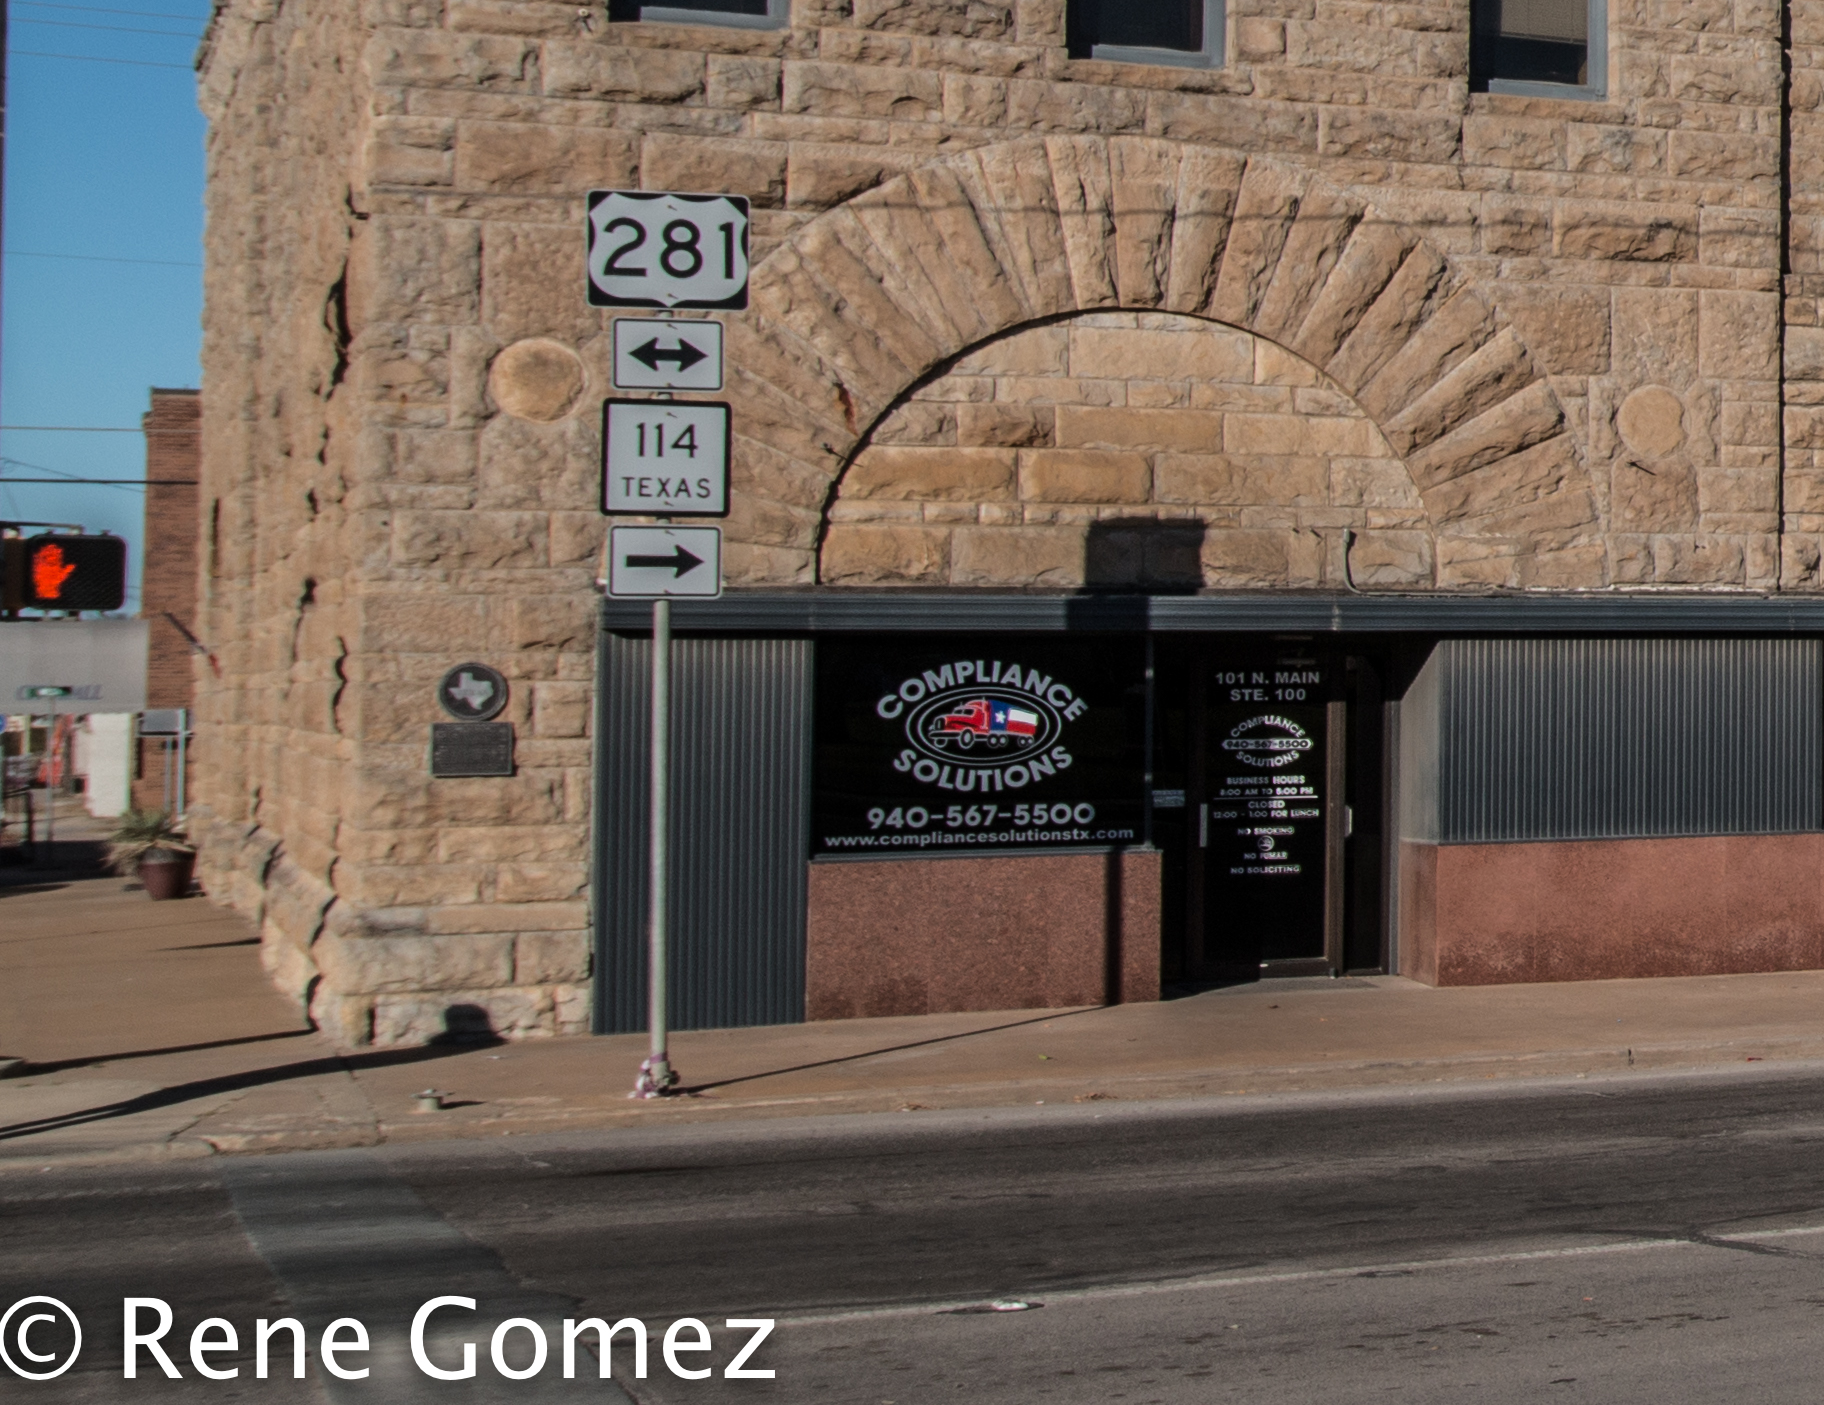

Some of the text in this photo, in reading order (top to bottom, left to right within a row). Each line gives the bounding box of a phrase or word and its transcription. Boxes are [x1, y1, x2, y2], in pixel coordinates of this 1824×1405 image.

[602, 216, 736, 280] 281
[635, 422, 699, 459] 114
[621, 476, 712, 499] TEXAS
[1215, 671, 1320, 684] 101 N. MAIN
[876, 659, 1089, 723] COMPLIANCE
[1230, 688, 1307, 701] STE. 100
[1230, 714, 1306, 737] COMPLIANCE
[1225, 738, 1310, 749] 940-567-5500
[1236, 750, 1300, 768] SOLUTIONS
[893, 745, 1074, 793] SOLUTIONS
[1226, 775, 1306, 785] BUSINESS HOURS
[1300, 786, 1314, 795] PM
[1248, 800, 1286, 809] CLOSED
[866, 802, 1096, 830] 940-567-5500
[1270, 809, 1288, 817] FOR
[1290, 808, 1319, 817] LUNCH
[1253, 826, 1295, 835] SMOKING
[824, 827, 1135, 848] www.compliancesolutionstx.com
[1243, 852, 1257, 860] NO
[1247, 864, 1301, 874] SOLICITING
